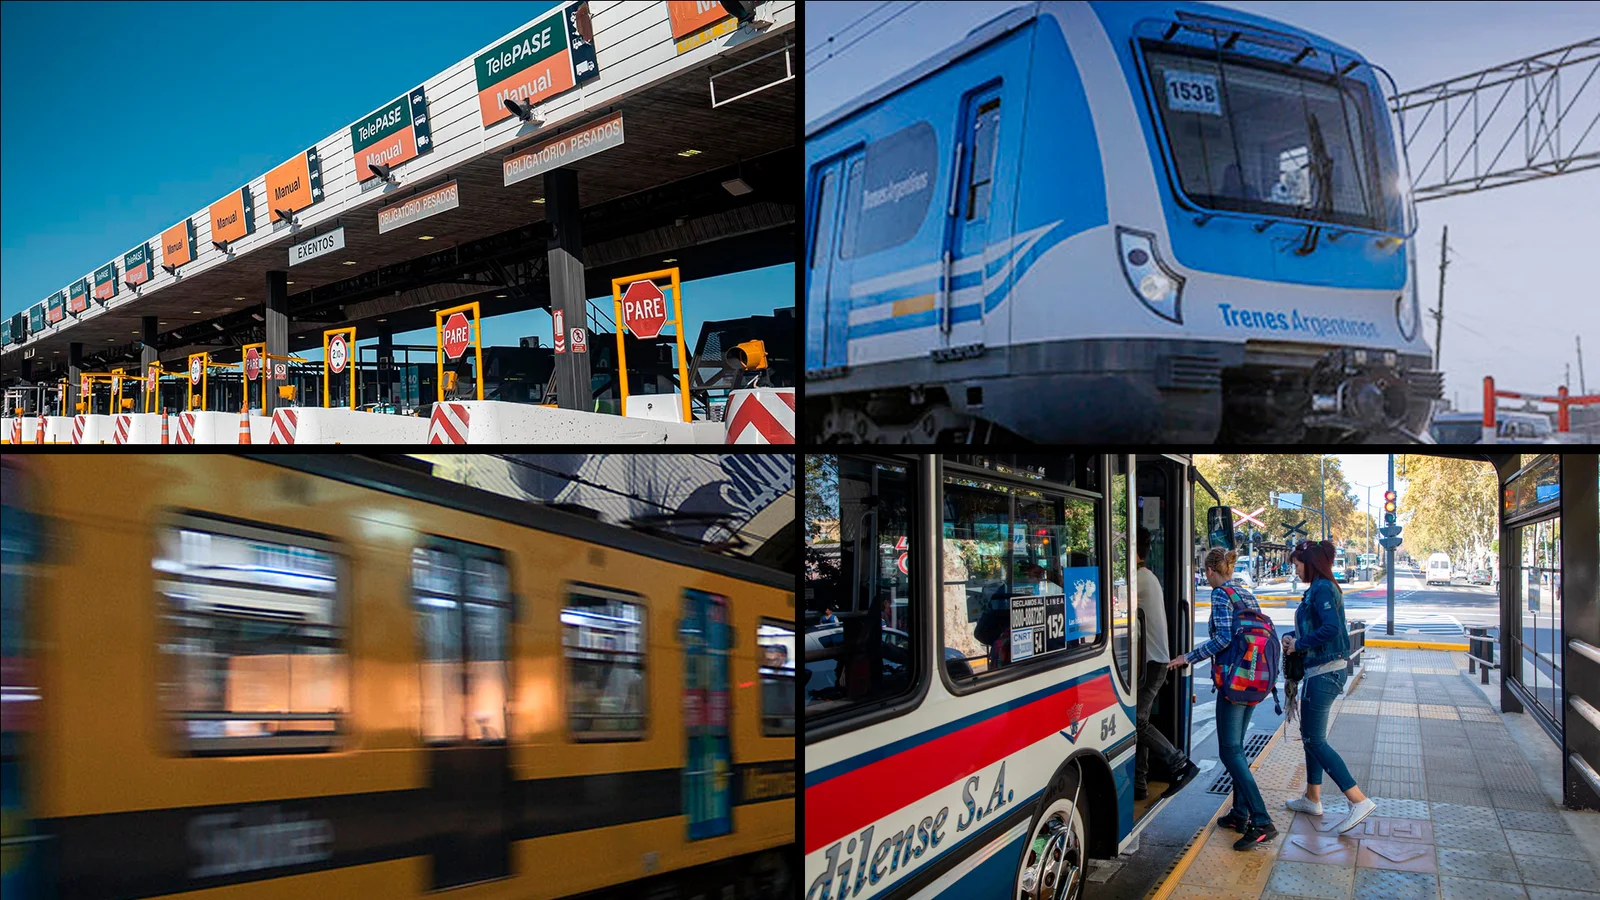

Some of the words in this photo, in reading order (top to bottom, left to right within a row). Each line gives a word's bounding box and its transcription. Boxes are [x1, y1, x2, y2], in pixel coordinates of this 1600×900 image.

[486, 27, 551, 76] TelePASE
[497, 69, 552, 110] Manual
[1170, 81, 1215, 102] 153B
[358, 105, 401, 142] TelePASE
[366, 139, 402, 168] Manual
[506, 141, 566, 177] OBLIGATORIO
[570, 120, 620, 151] PESADOS
[275, 177, 301, 201] Manual
[380, 201, 420, 226] OBLIGATORIO
[423, 188, 456, 211] PESADOS
[217, 210, 238, 230] Manual
[167, 238, 183, 255] Manual
[298, 235, 334, 259] EXENTOS
[625, 298, 663, 320] PARE
[1218, 303, 1289, 330] Trenes
[445, 326, 468, 345] PARE
[246, 357, 259, 370] PARE
[1012, 599, 1037, 607] RECLAMOS
[1046, 597, 1064, 606] LINEA
[1013, 631, 1031, 642] CNRT
[1047, 613, 1064, 639] 152
[1034, 632, 1043, 653] 54
[1101, 713, 1116, 741] 54
[956, 761, 1014, 833] S.A.
